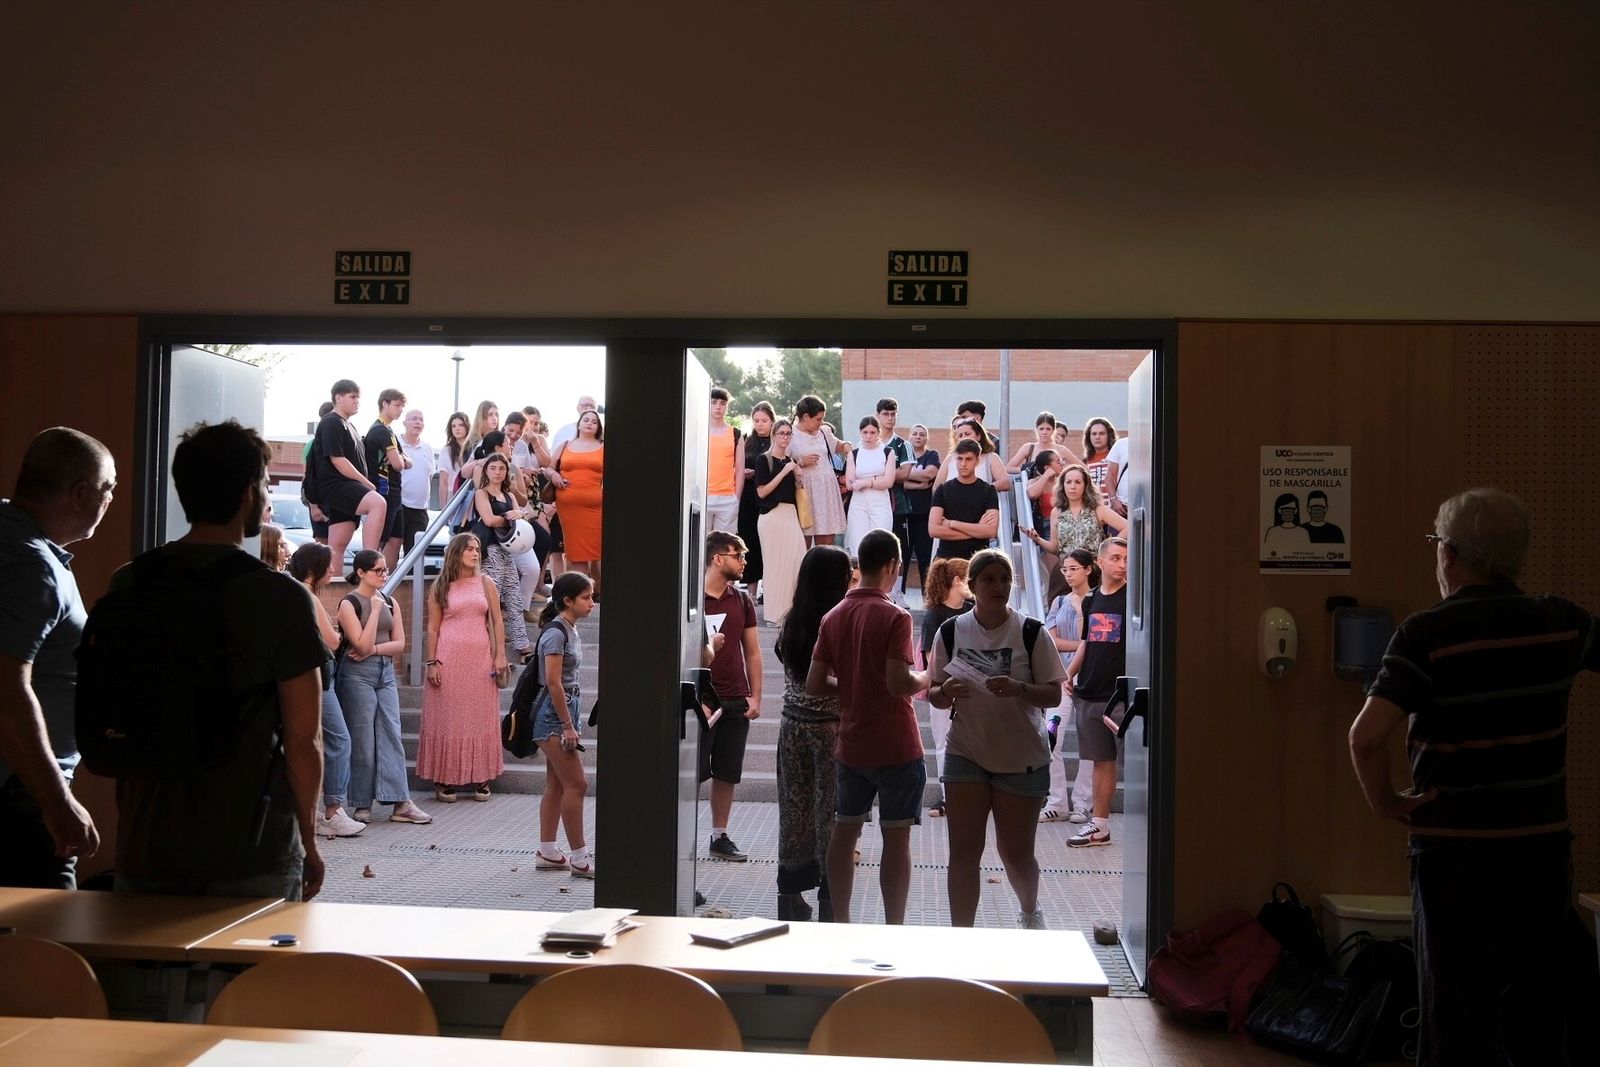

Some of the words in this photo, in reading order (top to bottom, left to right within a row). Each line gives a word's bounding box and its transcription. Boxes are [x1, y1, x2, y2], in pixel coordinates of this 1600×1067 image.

[341, 255, 404, 272] SALIDA
[894, 254, 962, 272] SALIDA
[340, 283, 405, 300] EXIT
[893, 284, 963, 301] EXIT
[1263, 468, 1282, 477] USO
[1285, 468, 1349, 477] RESPONSABLE
[1269, 479, 1281, 488] DE
[1284, 479, 1342, 488] MASCARILLA
